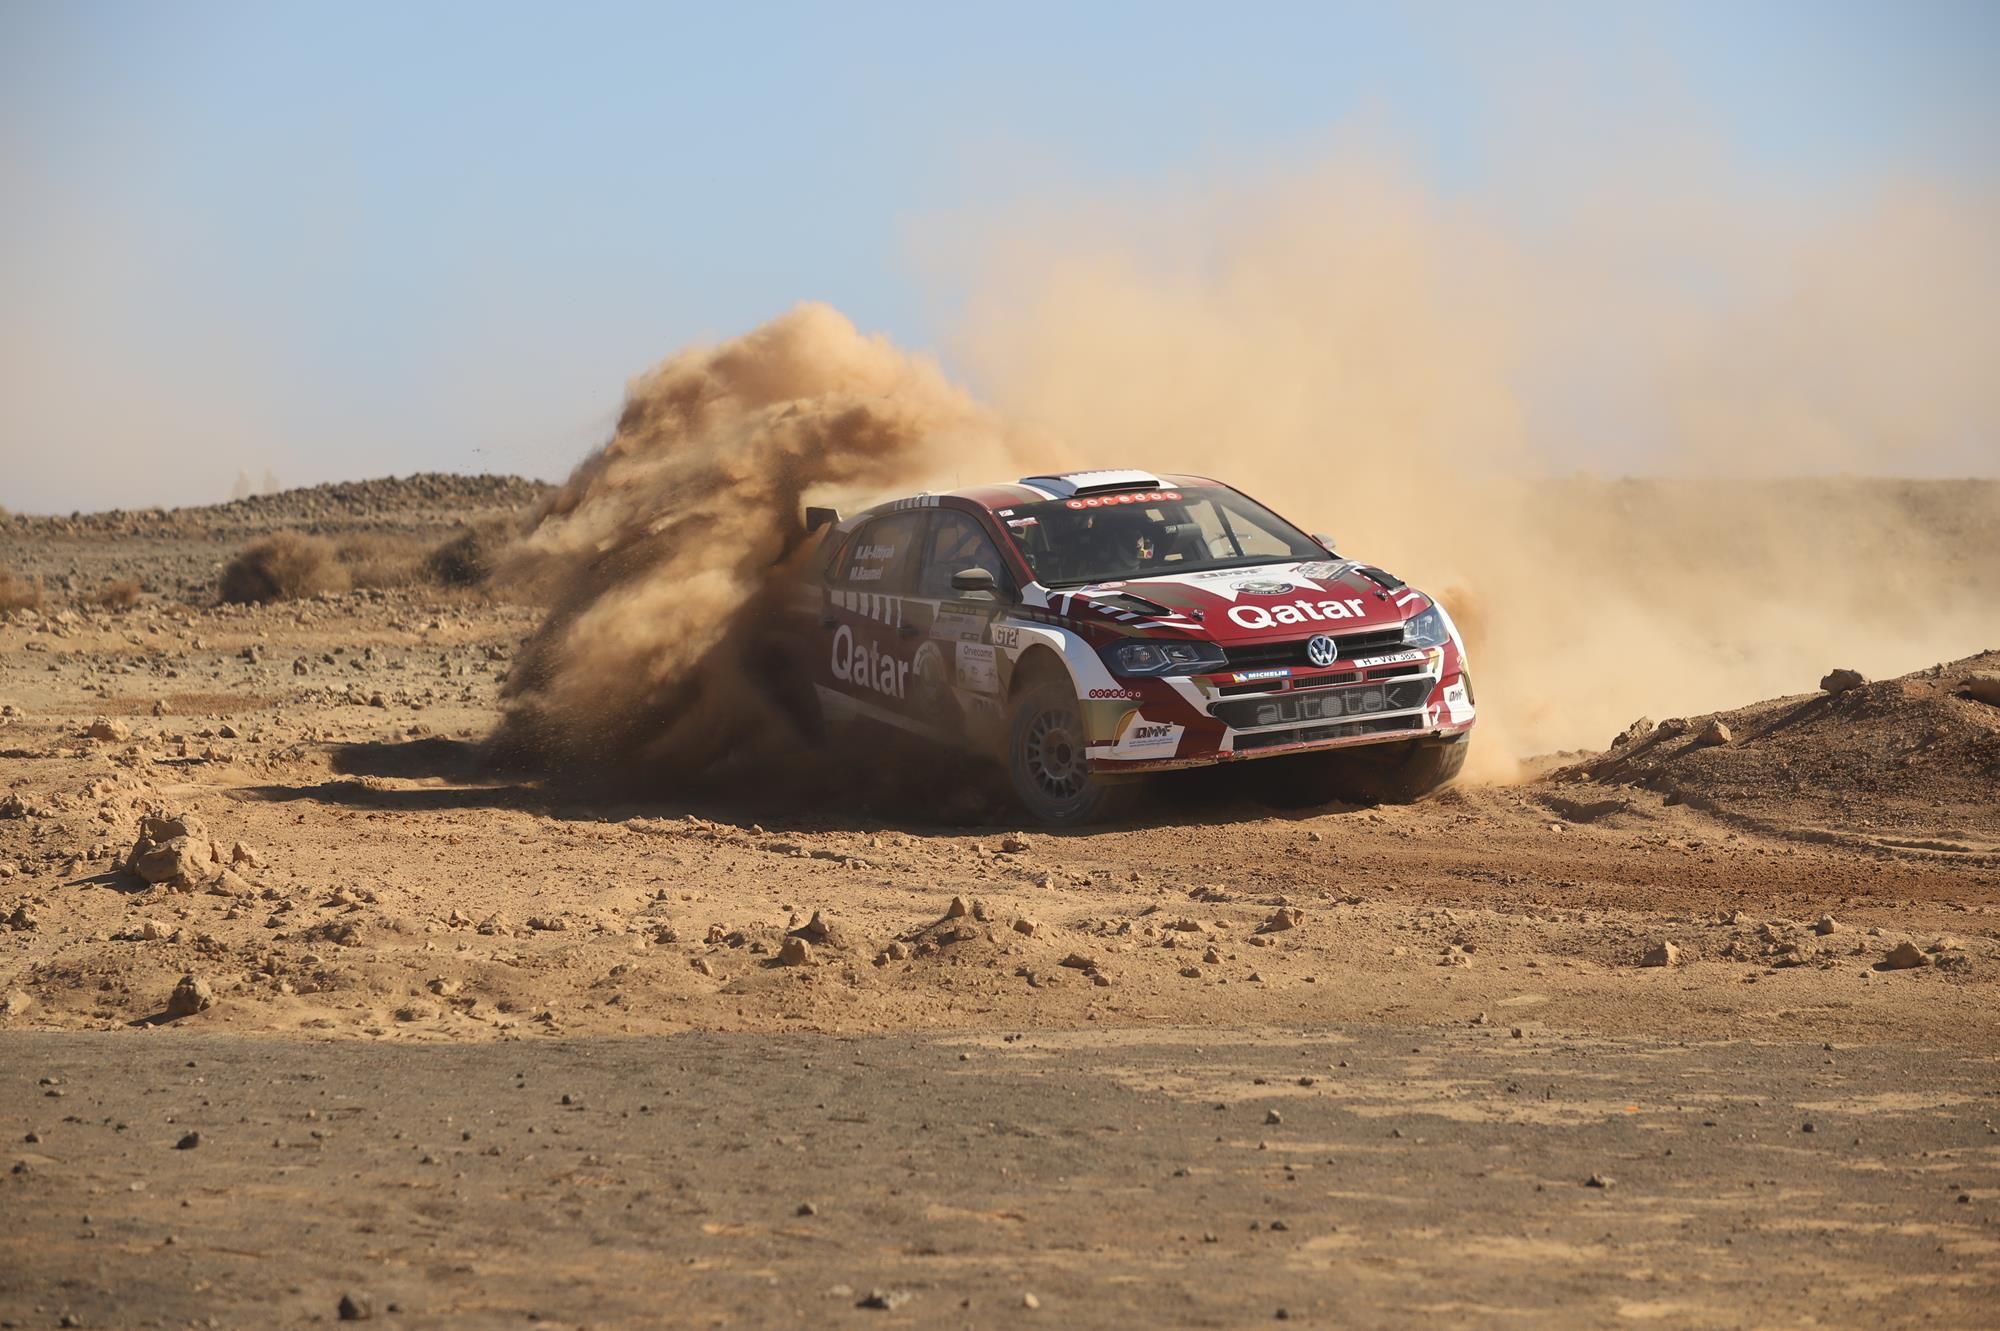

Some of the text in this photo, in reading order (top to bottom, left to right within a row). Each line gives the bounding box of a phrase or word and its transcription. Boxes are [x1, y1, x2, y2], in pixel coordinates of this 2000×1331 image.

[1227, 598, 1366, 630] Qatar
[831, 624, 909, 699] Qatar
[1248, 670, 1288, 680] MICHELIN
[1089, 688, 1141, 698] ooredoo
[1256, 684, 1401, 725] autotek
